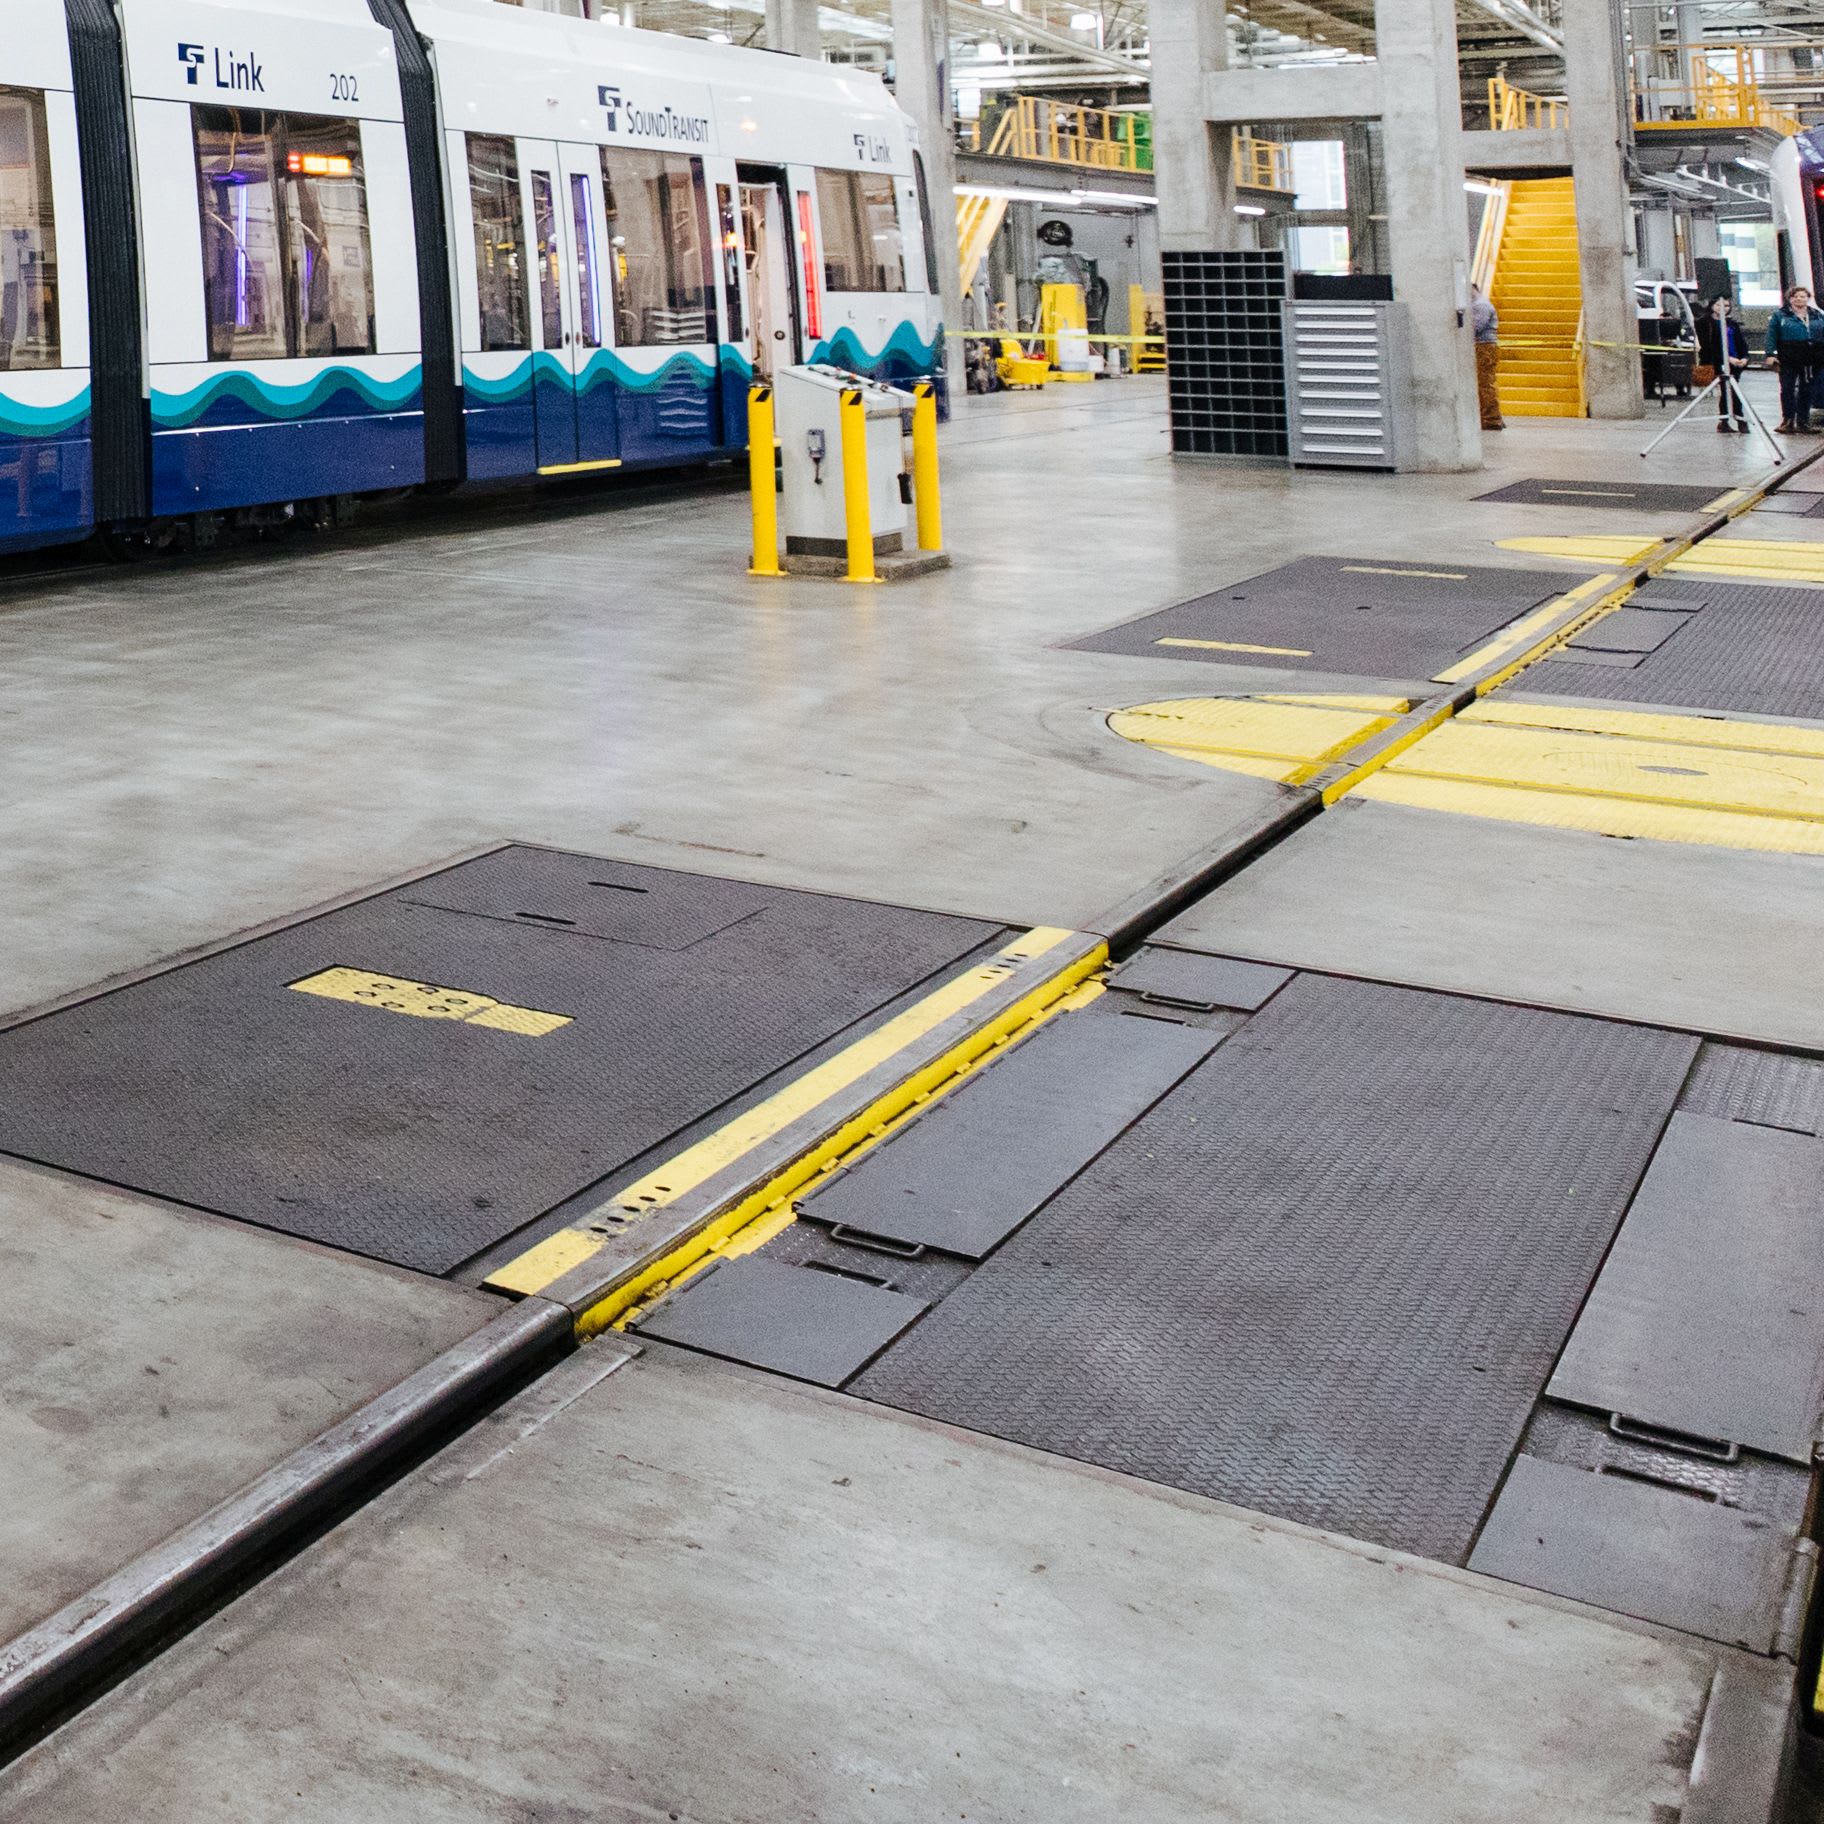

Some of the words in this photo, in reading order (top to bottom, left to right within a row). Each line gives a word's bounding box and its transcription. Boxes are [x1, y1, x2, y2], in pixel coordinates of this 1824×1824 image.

[215, 48, 266, 93] Link
[330, 74, 360, 102] 202
[868, 135, 892, 164] Link
